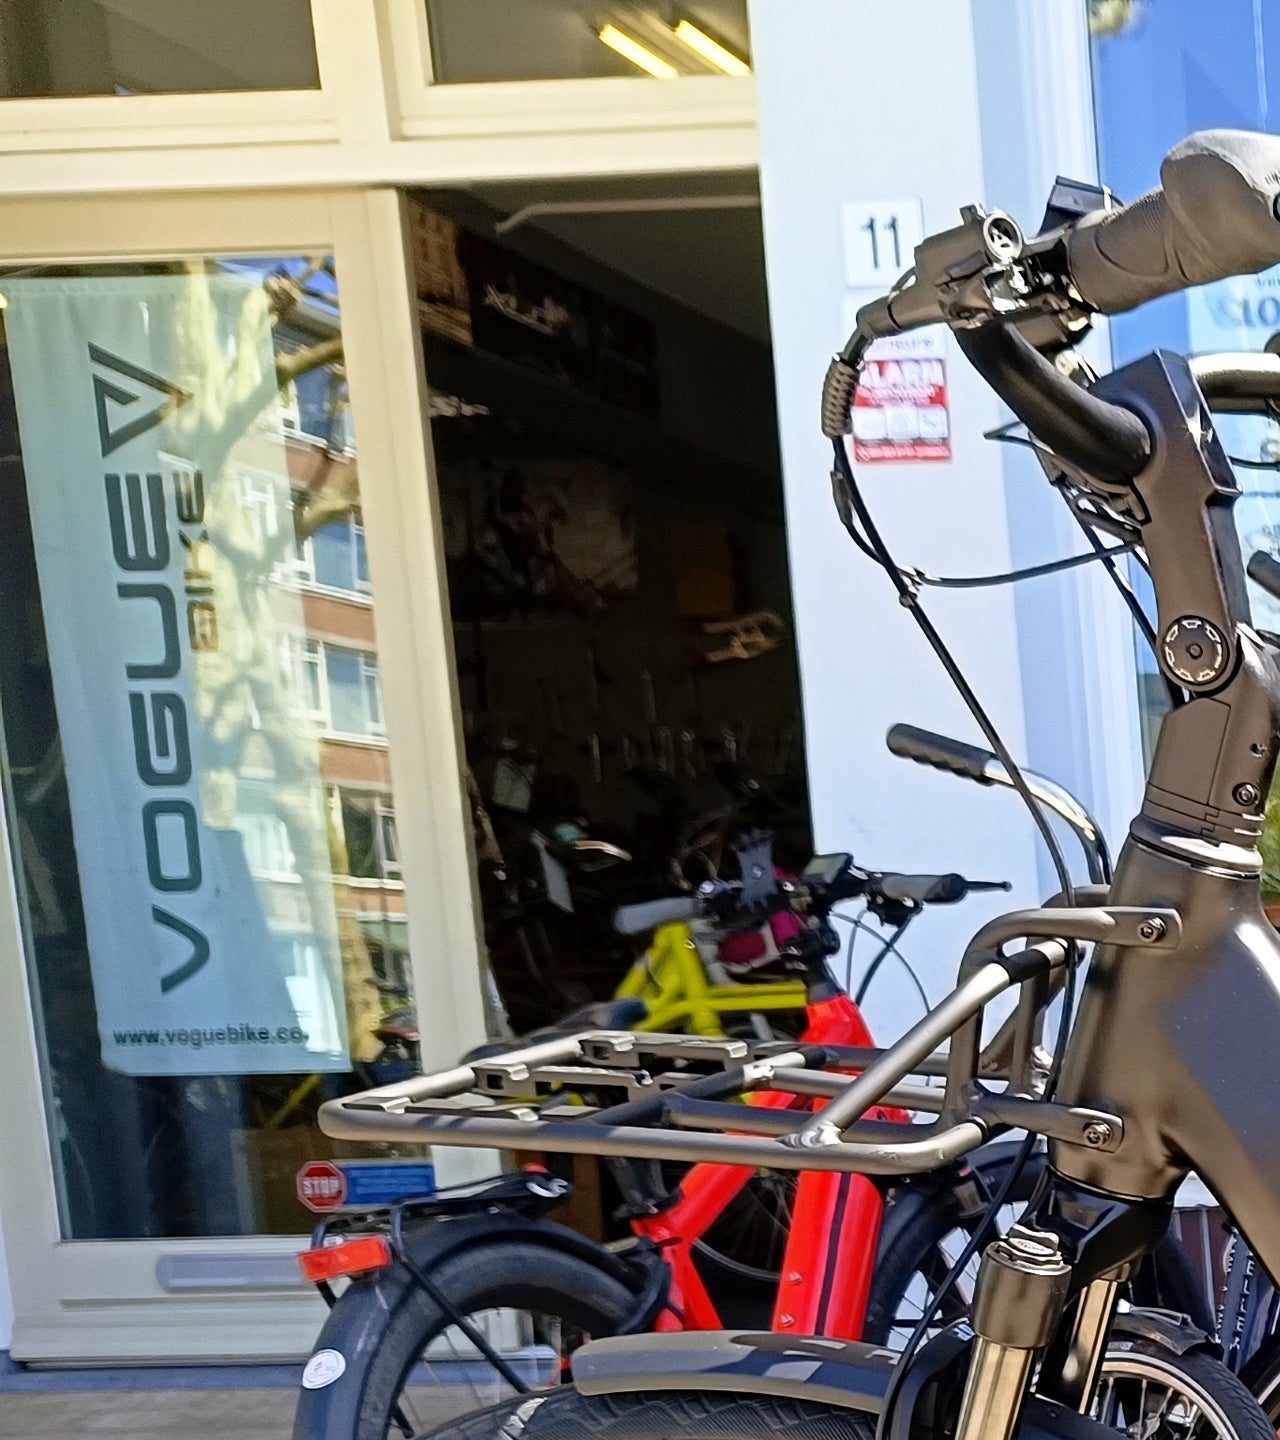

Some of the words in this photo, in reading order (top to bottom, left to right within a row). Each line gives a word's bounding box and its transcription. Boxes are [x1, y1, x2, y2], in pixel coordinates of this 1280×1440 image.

[859, 215, 901, 269] 11
[104, 472, 211, 996] VOGUE
[112, 1022, 309, 1050] www.voguebike.co
[302, 1176, 340, 1198] STOP
